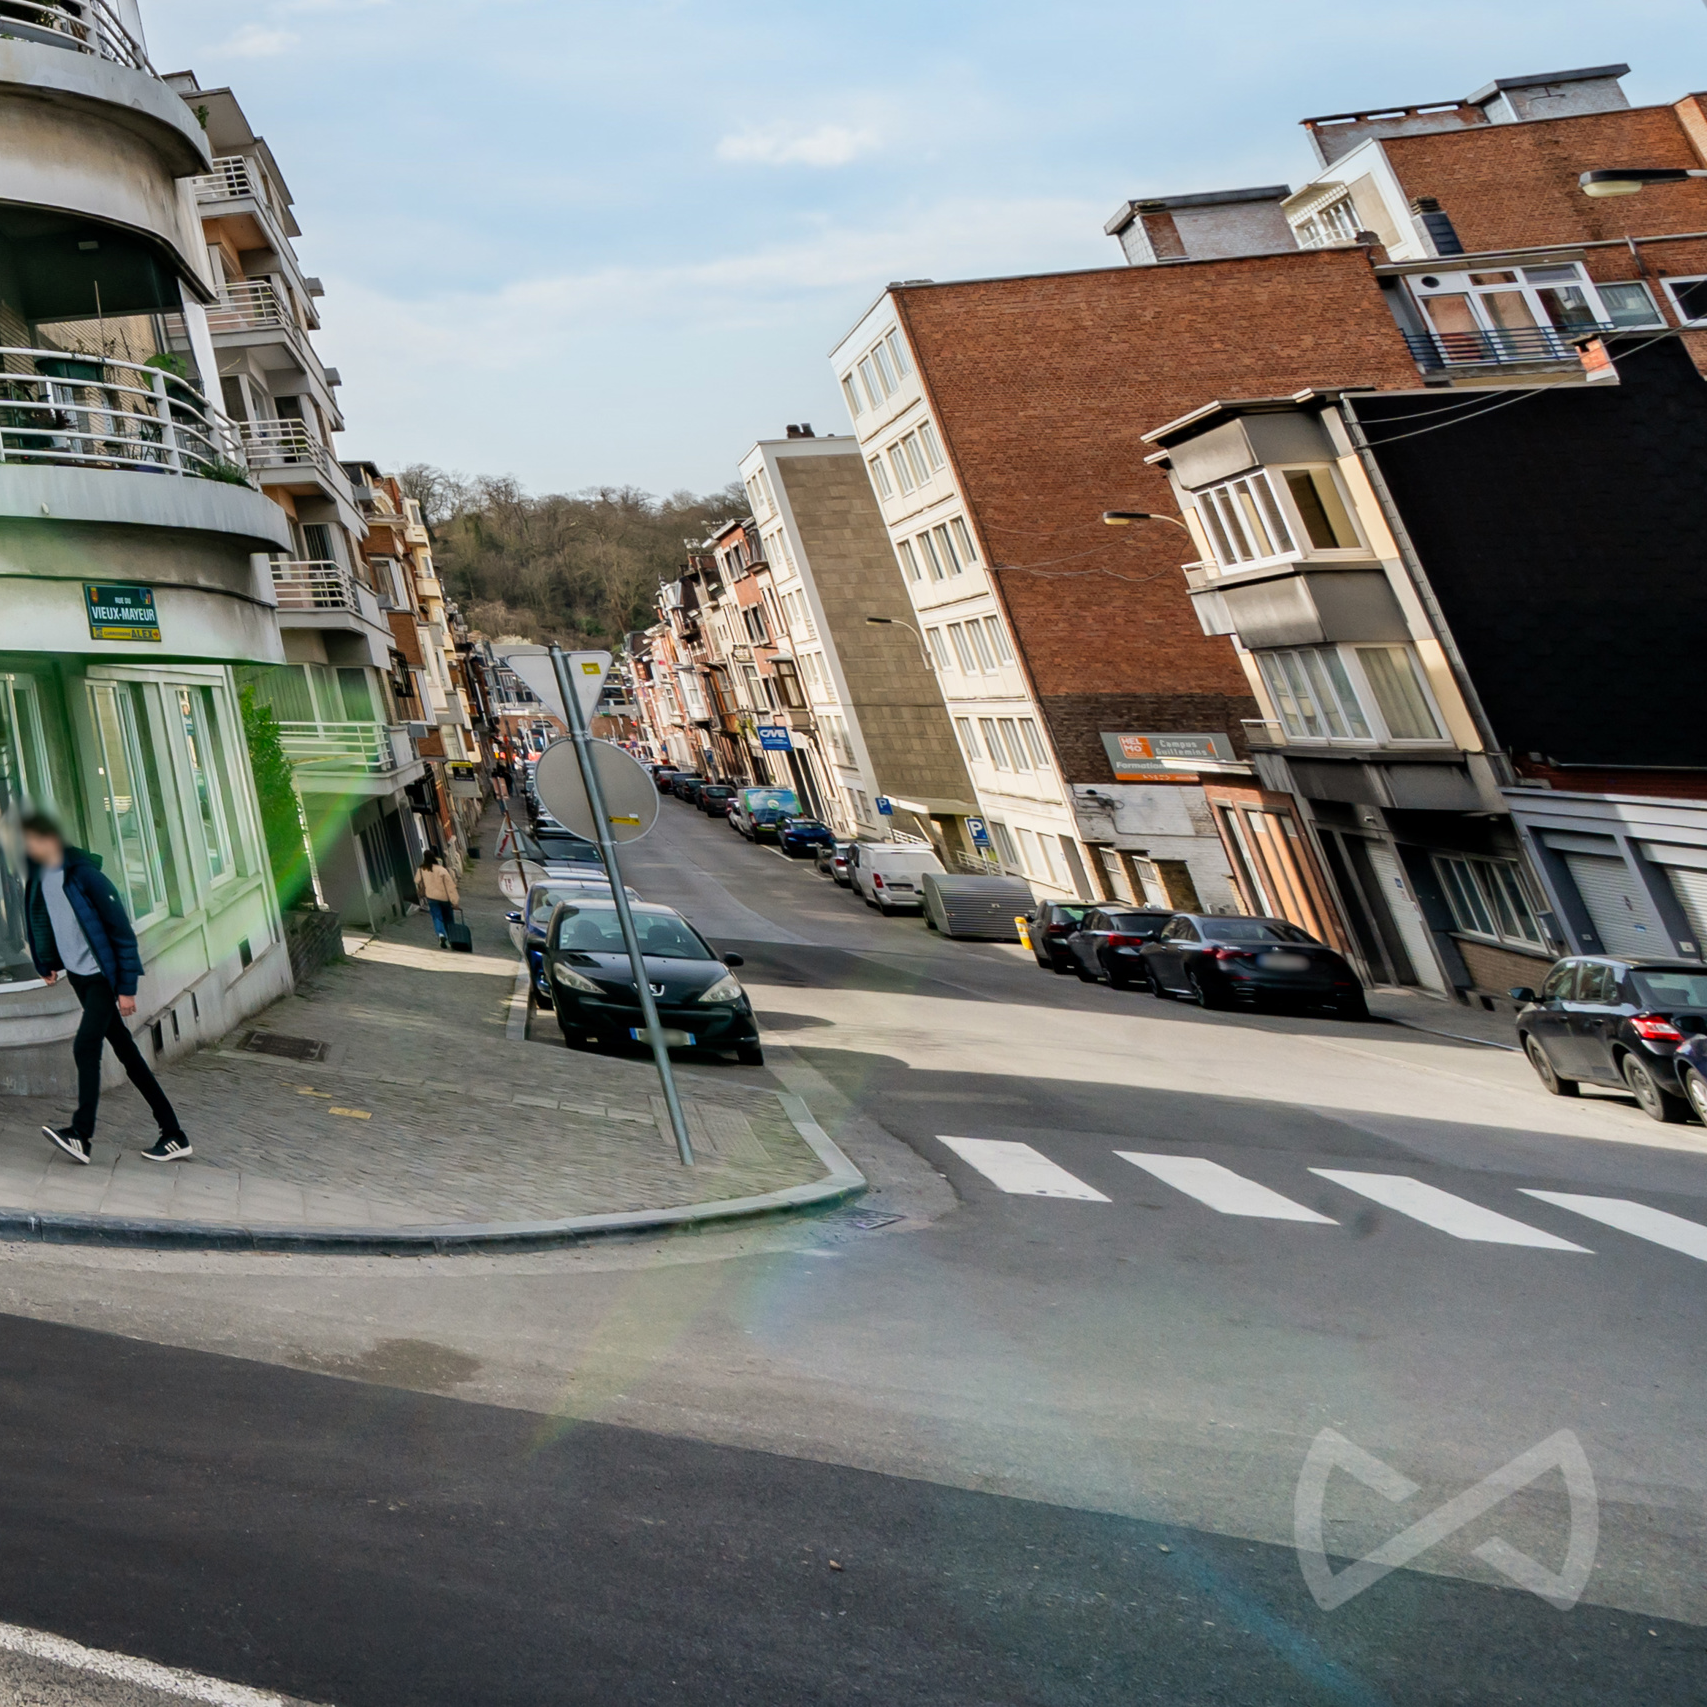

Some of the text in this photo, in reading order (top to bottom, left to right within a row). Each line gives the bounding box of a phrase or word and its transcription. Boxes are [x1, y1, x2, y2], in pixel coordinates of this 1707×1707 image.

[91, 606, 155, 621] VIEUX-MAYEUR
[131, 629, 153, 638] ALEX
[1159, 739, 1197, 748] Campus
[1155, 748, 1208, 756] Guillemins
[878, 799, 888, 808] P
[968, 821, 983, 836] P
